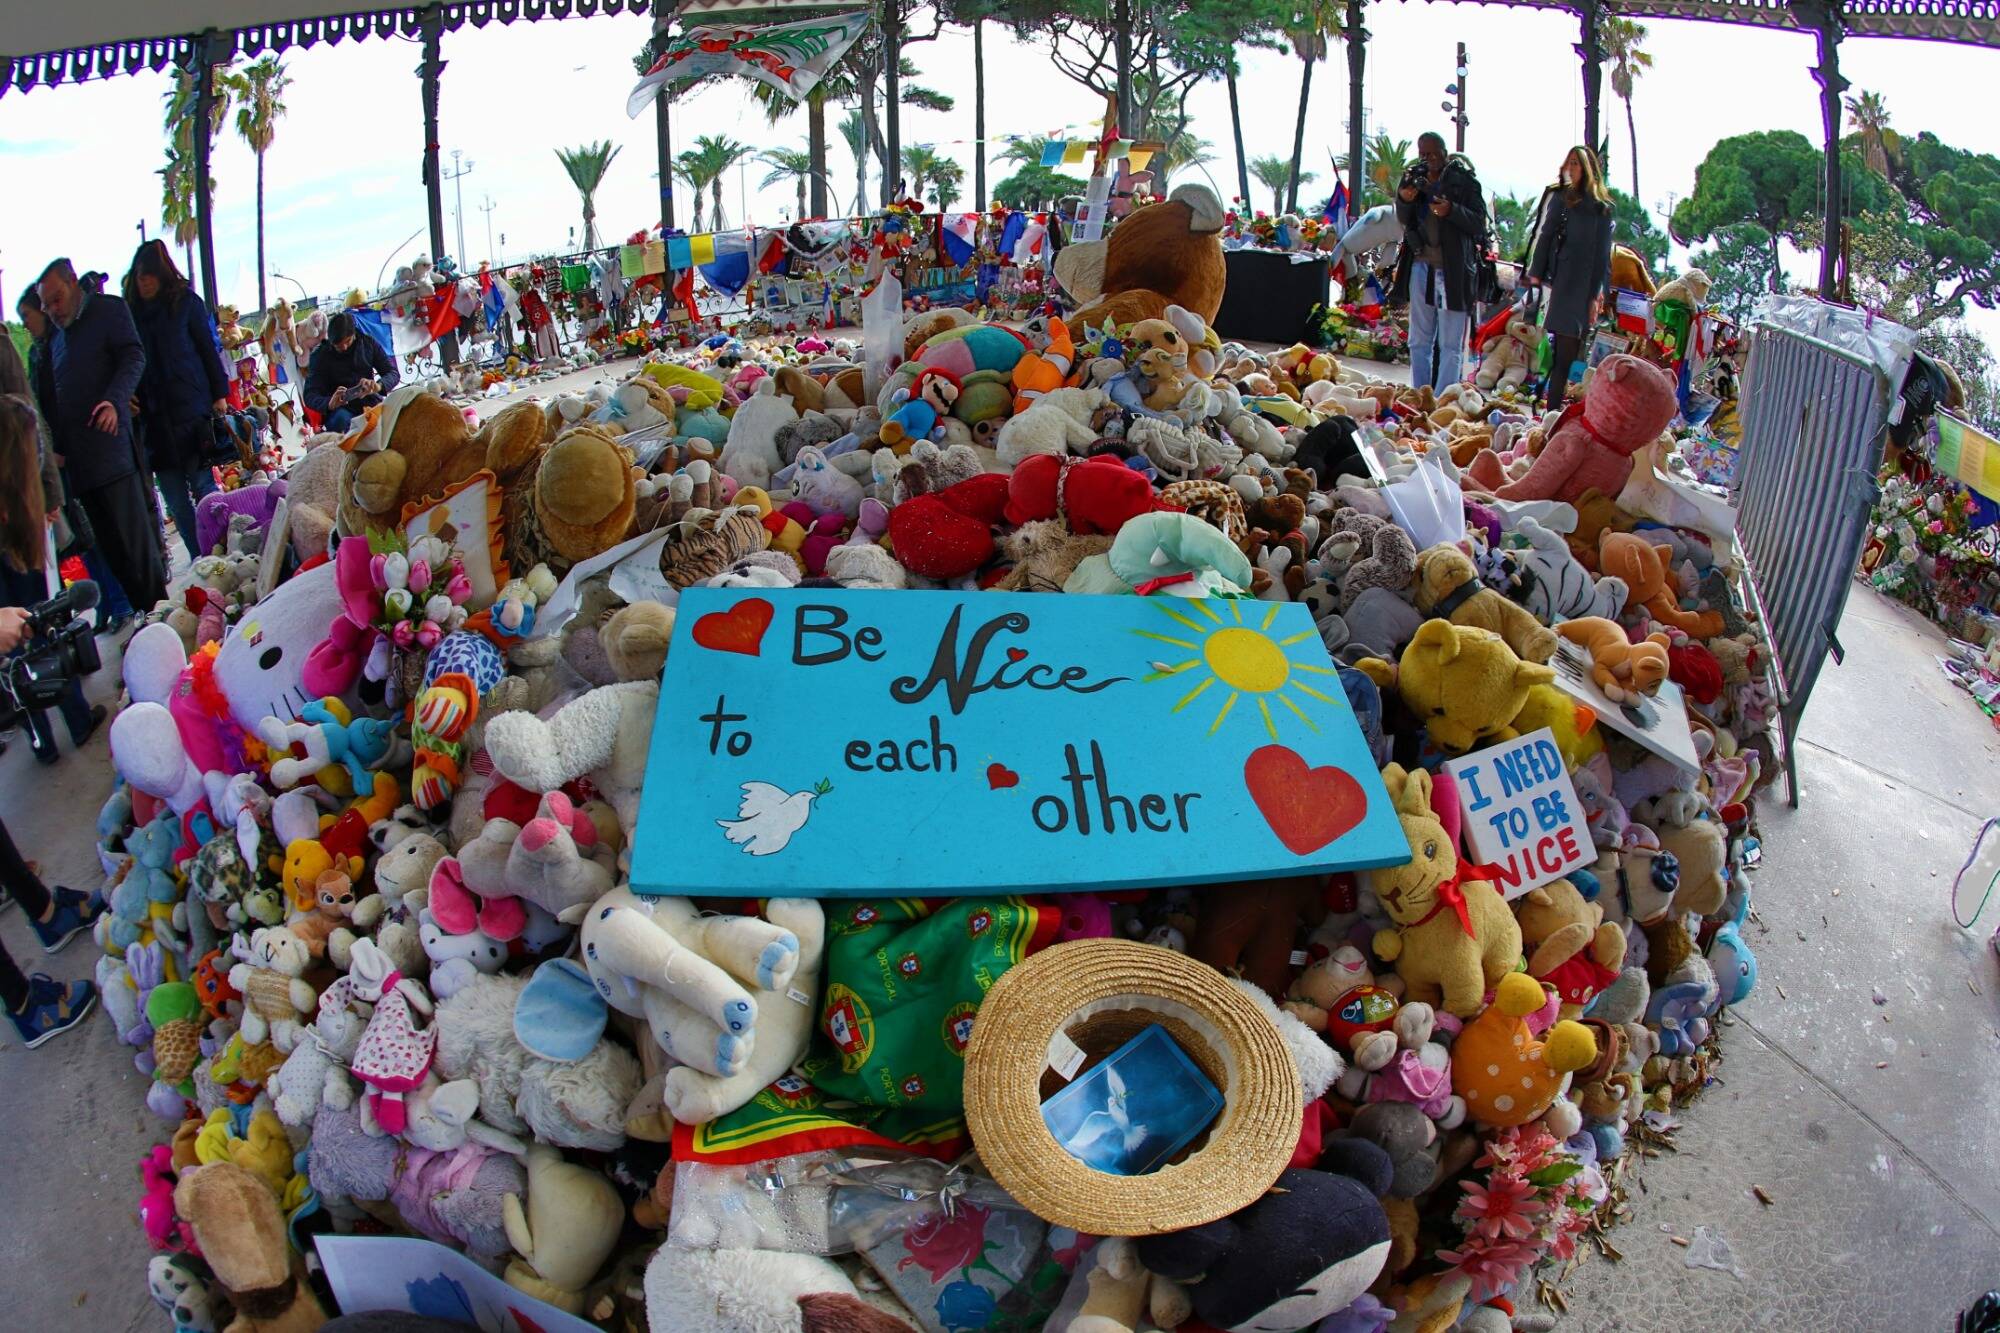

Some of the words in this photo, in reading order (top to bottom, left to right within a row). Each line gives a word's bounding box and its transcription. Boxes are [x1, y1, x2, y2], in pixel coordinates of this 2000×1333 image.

[792, 605, 886, 667] Be
[890, 604, 1131, 716] Nice
[698, 695, 753, 757] to
[845, 715, 958, 773] each
[1032, 740, 1202, 836] other
[1459, 766, 1493, 812] I
[1493, 740, 1562, 798] NEED
[1489, 807, 1530, 848] TO
[1532, 790, 1571, 832] BE
[1491, 826, 1581, 896] NICE
